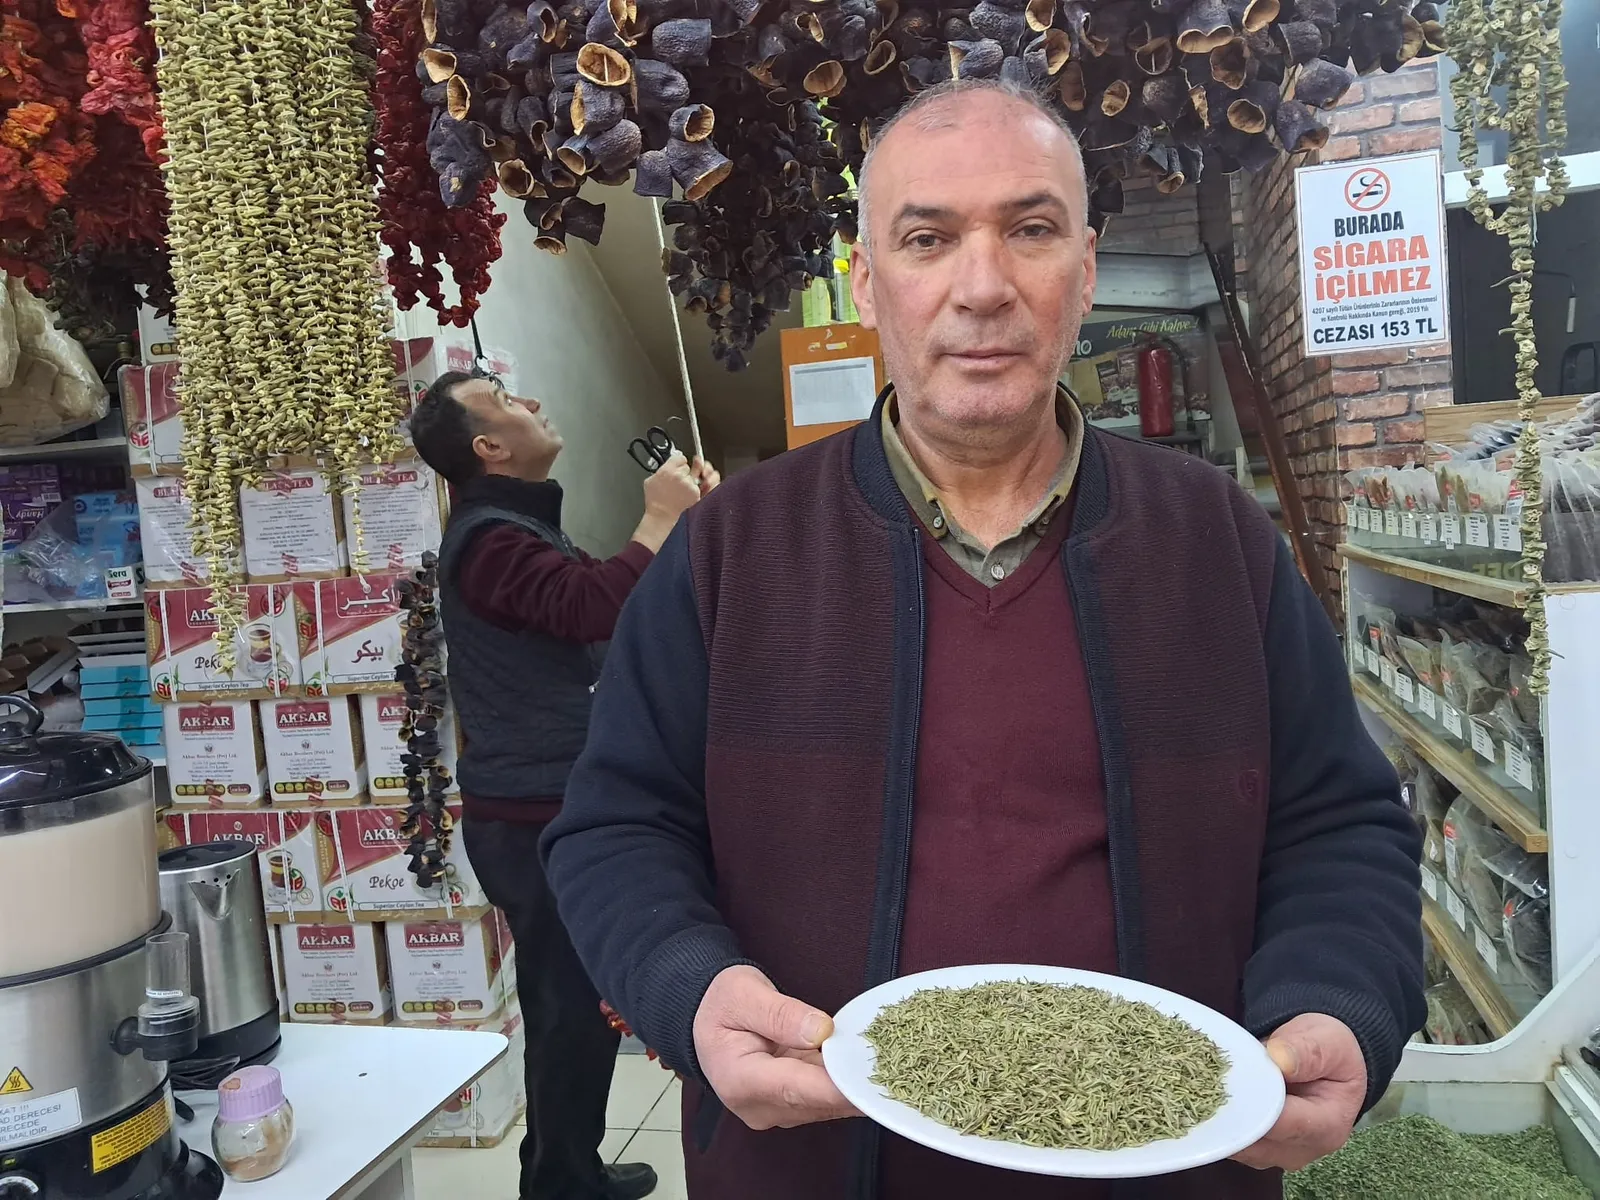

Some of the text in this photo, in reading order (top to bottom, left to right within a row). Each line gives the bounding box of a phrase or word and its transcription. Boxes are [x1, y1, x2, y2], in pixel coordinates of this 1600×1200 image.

[1334, 210, 1405, 237] BURADA
[1313, 235, 1429, 271] SİGARA
[1315, 265, 1431, 304] İÇİLMEZ
[1312, 307, 1325, 315] 4207
[1326, 306, 1339, 315] sayılı
[1339, 304, 1352, 312] Tütün
[1411, 295, 1438, 304] Önlenmesi
[1327, 313, 1348, 321] Kontrolü
[1348, 310, 1372, 320] Hakkında
[1372, 309, 1388, 317] Kanun
[1407, 305, 1420, 314] 2019
[1313, 317, 1438, 344] CEZASI 153 TL
[15, 507, 45, 519] Handy
[351, 639, 384, 663] بيكو
[369, 873, 405, 890] Pekoe
[409, 932, 460, 944] AKBAR
